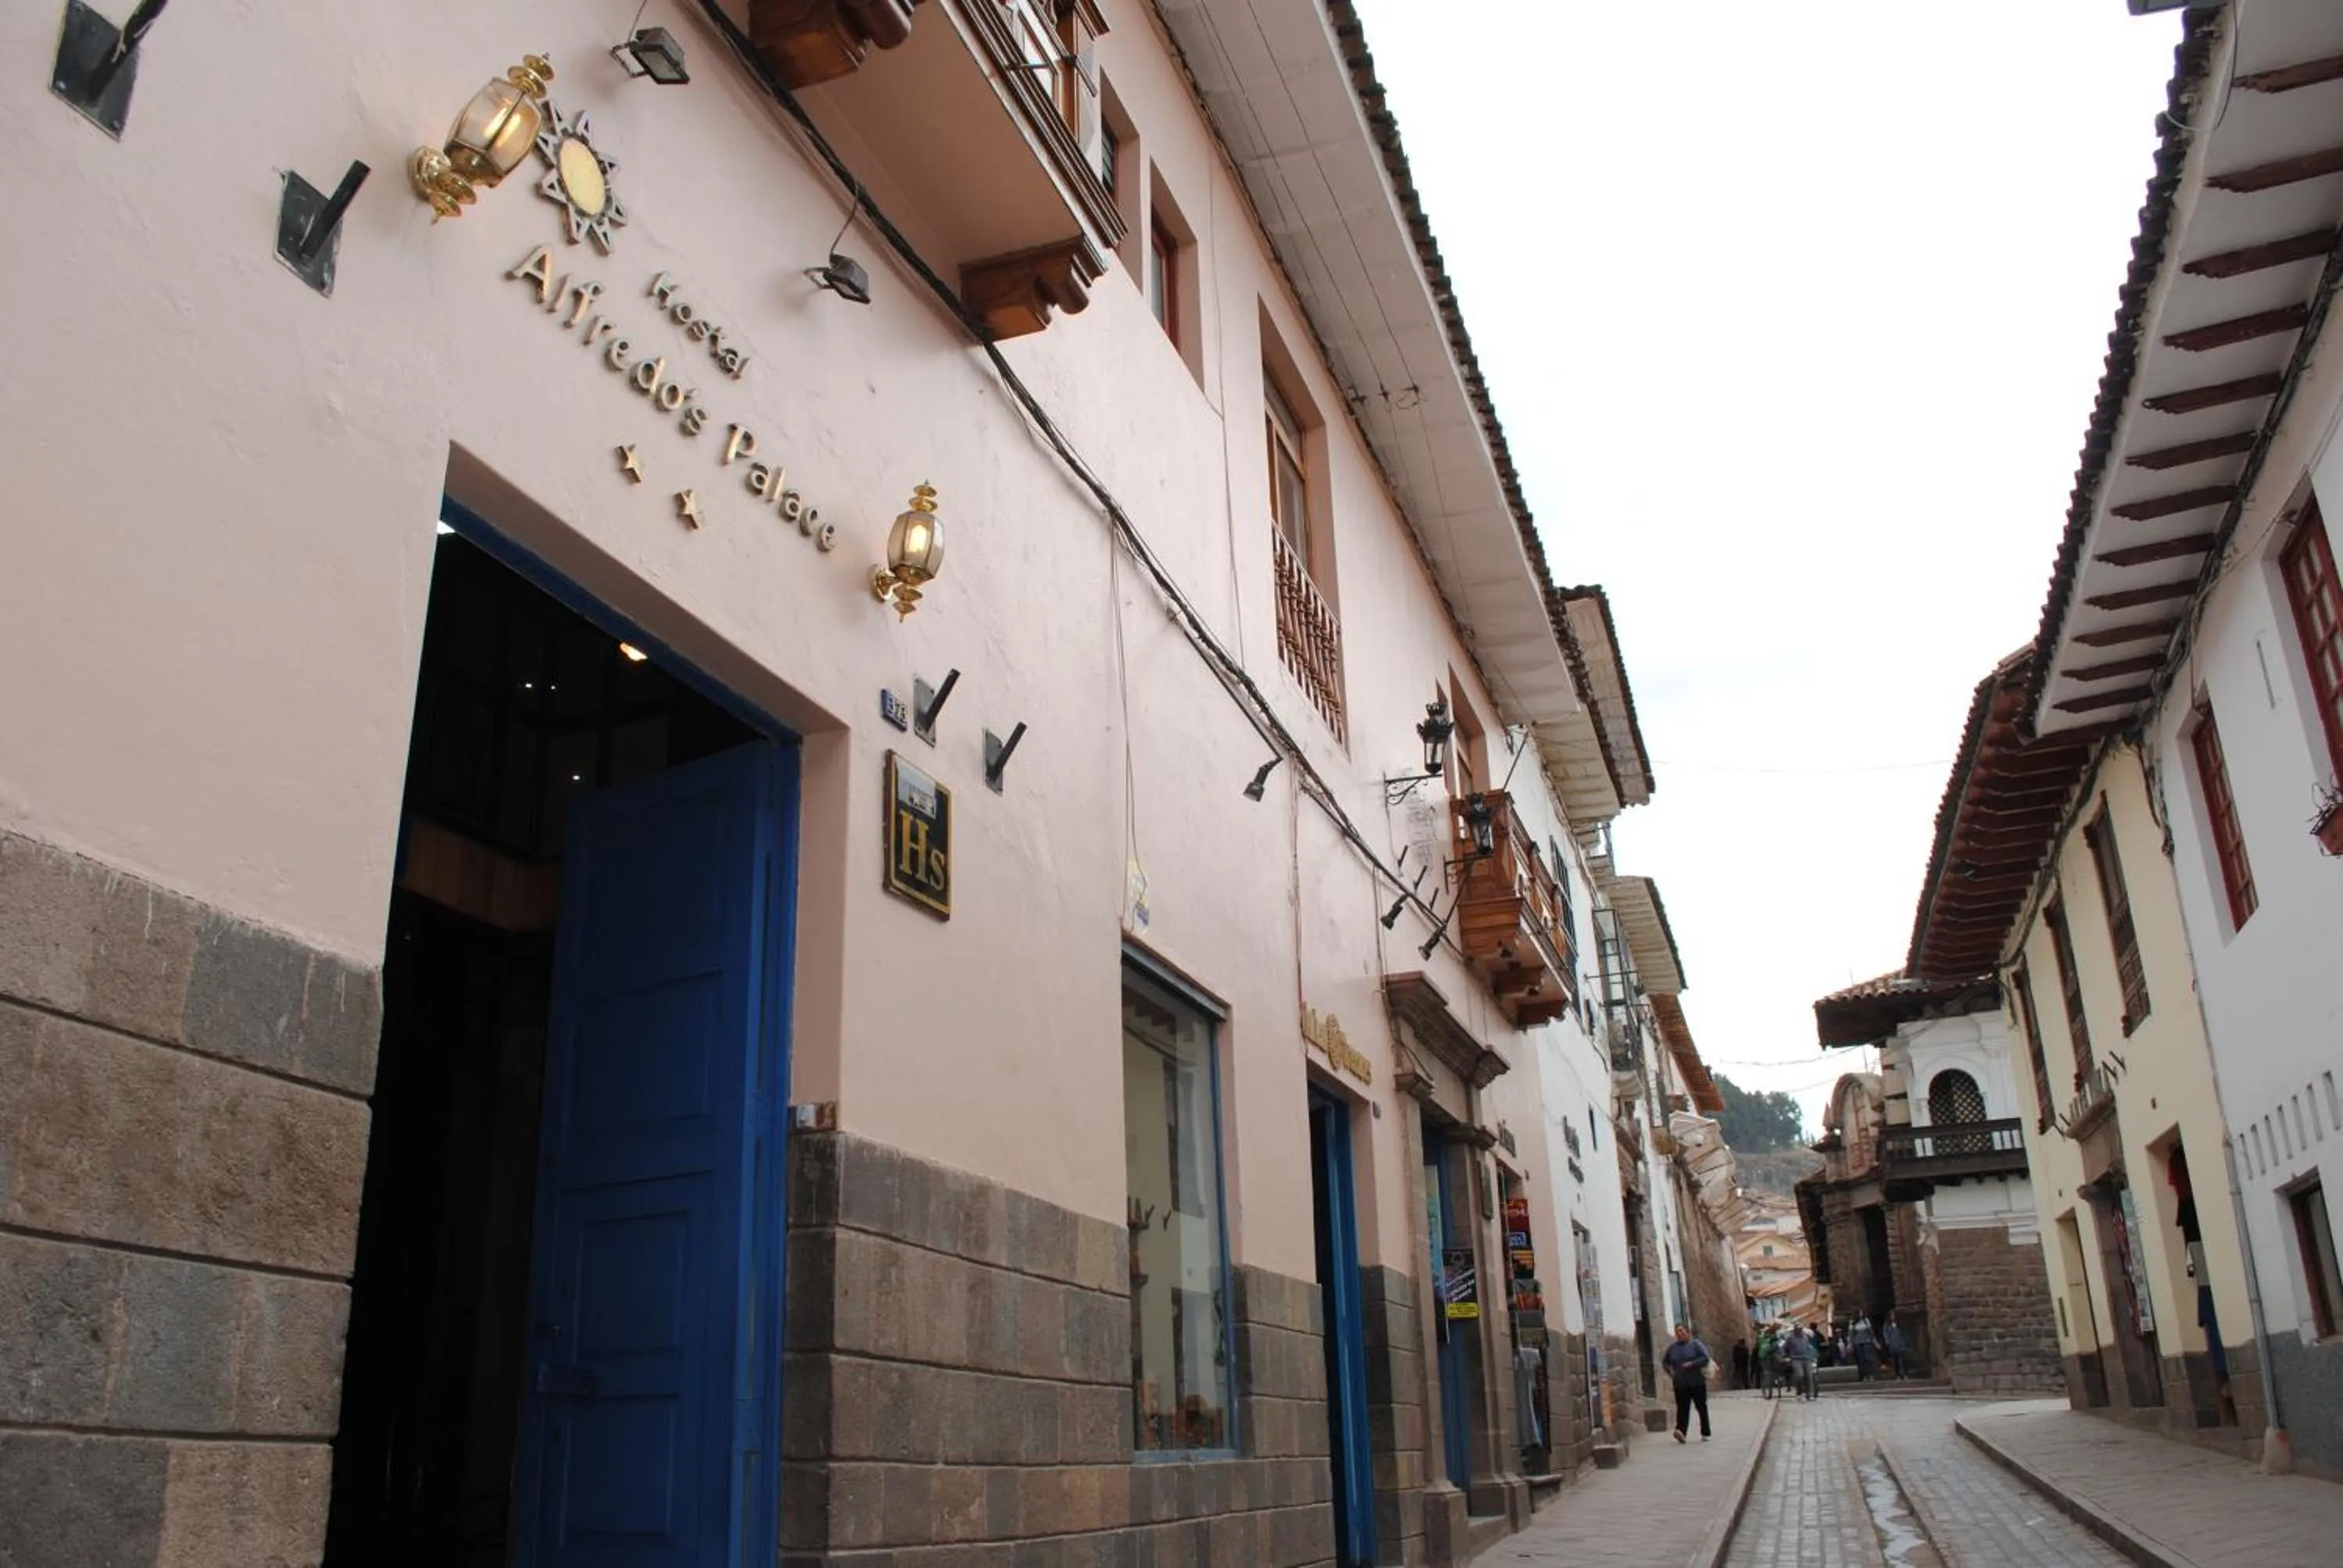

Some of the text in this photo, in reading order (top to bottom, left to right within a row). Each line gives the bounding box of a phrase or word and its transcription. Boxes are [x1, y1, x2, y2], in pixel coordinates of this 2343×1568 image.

[505, 244, 836, 551] Alfredo's Palace
[647, 271, 751, 380] Hostal
